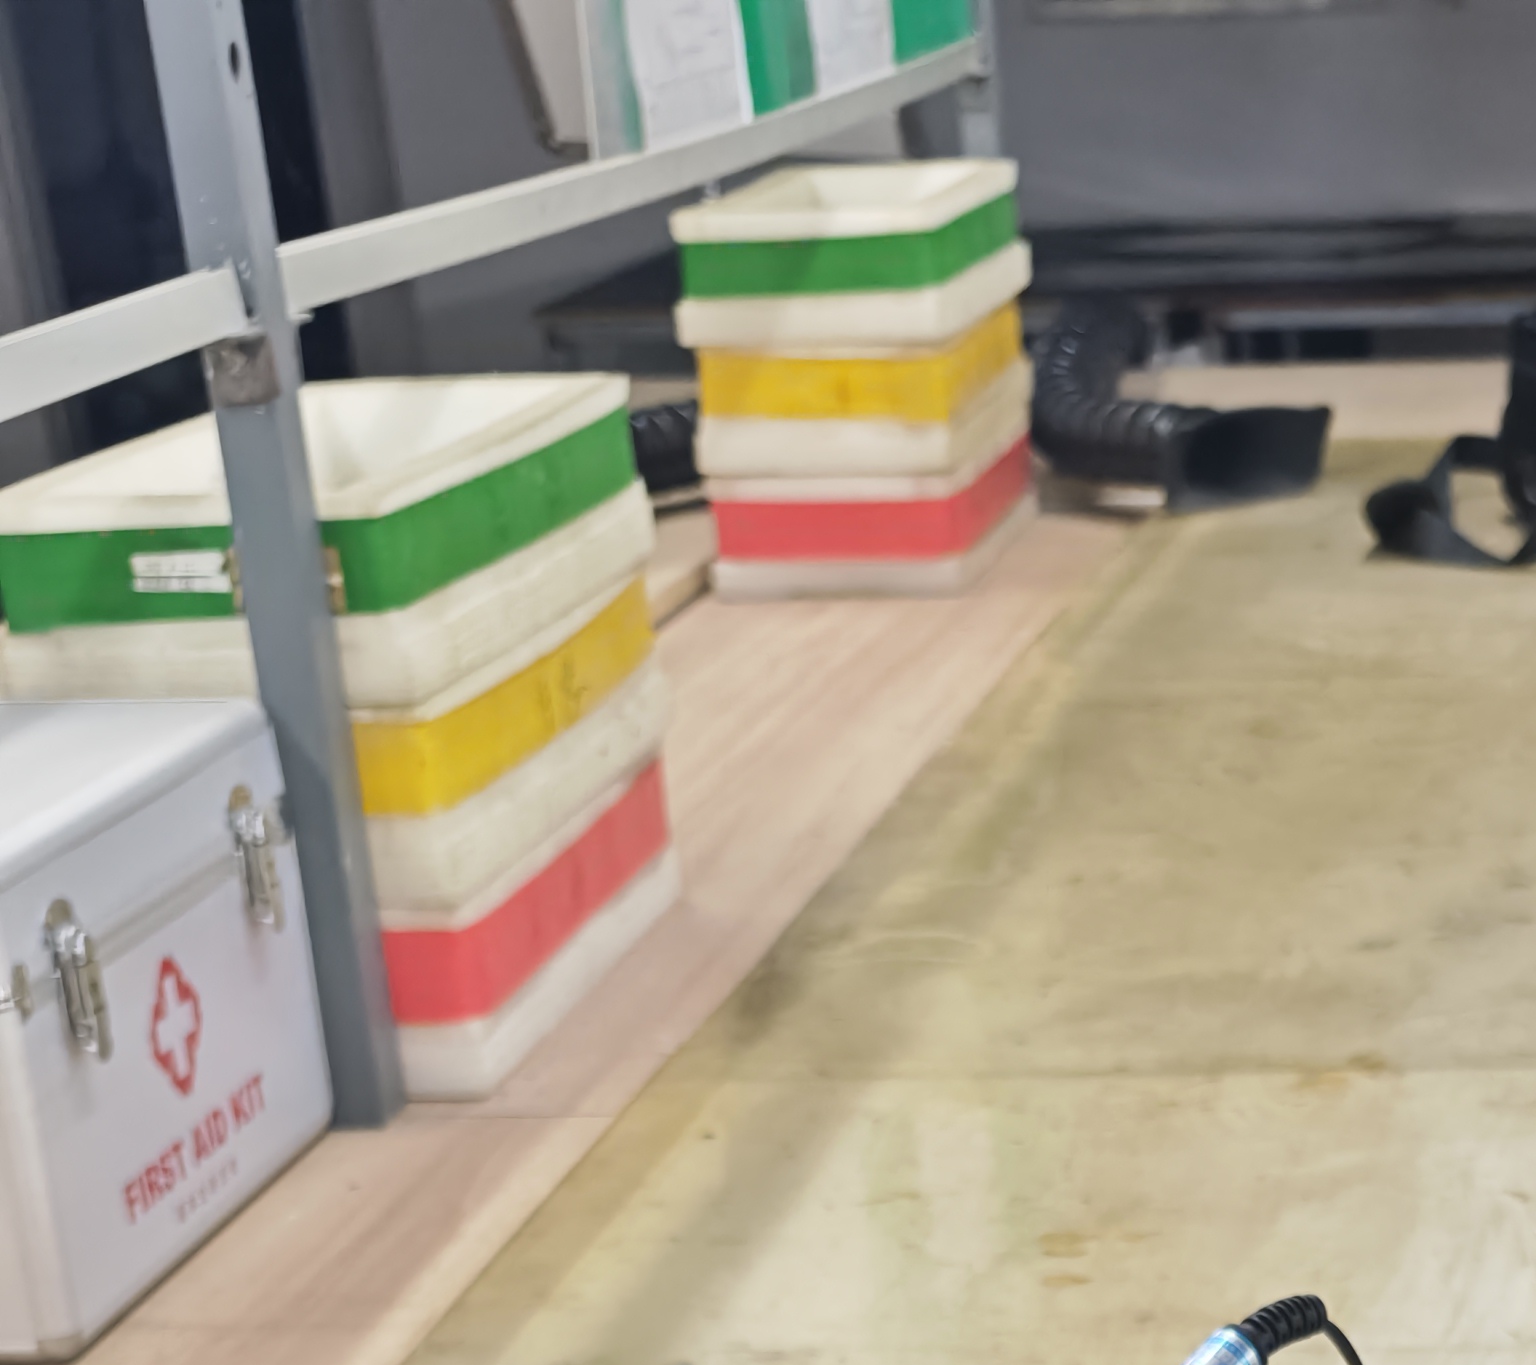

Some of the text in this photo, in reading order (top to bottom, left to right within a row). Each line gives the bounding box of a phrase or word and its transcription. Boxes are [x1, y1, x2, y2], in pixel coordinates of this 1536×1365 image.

[124, 1141, 187, 1224] FIRST
[192, 1109, 228, 1161] AID
[229, 1073, 265, 1129] KIT
